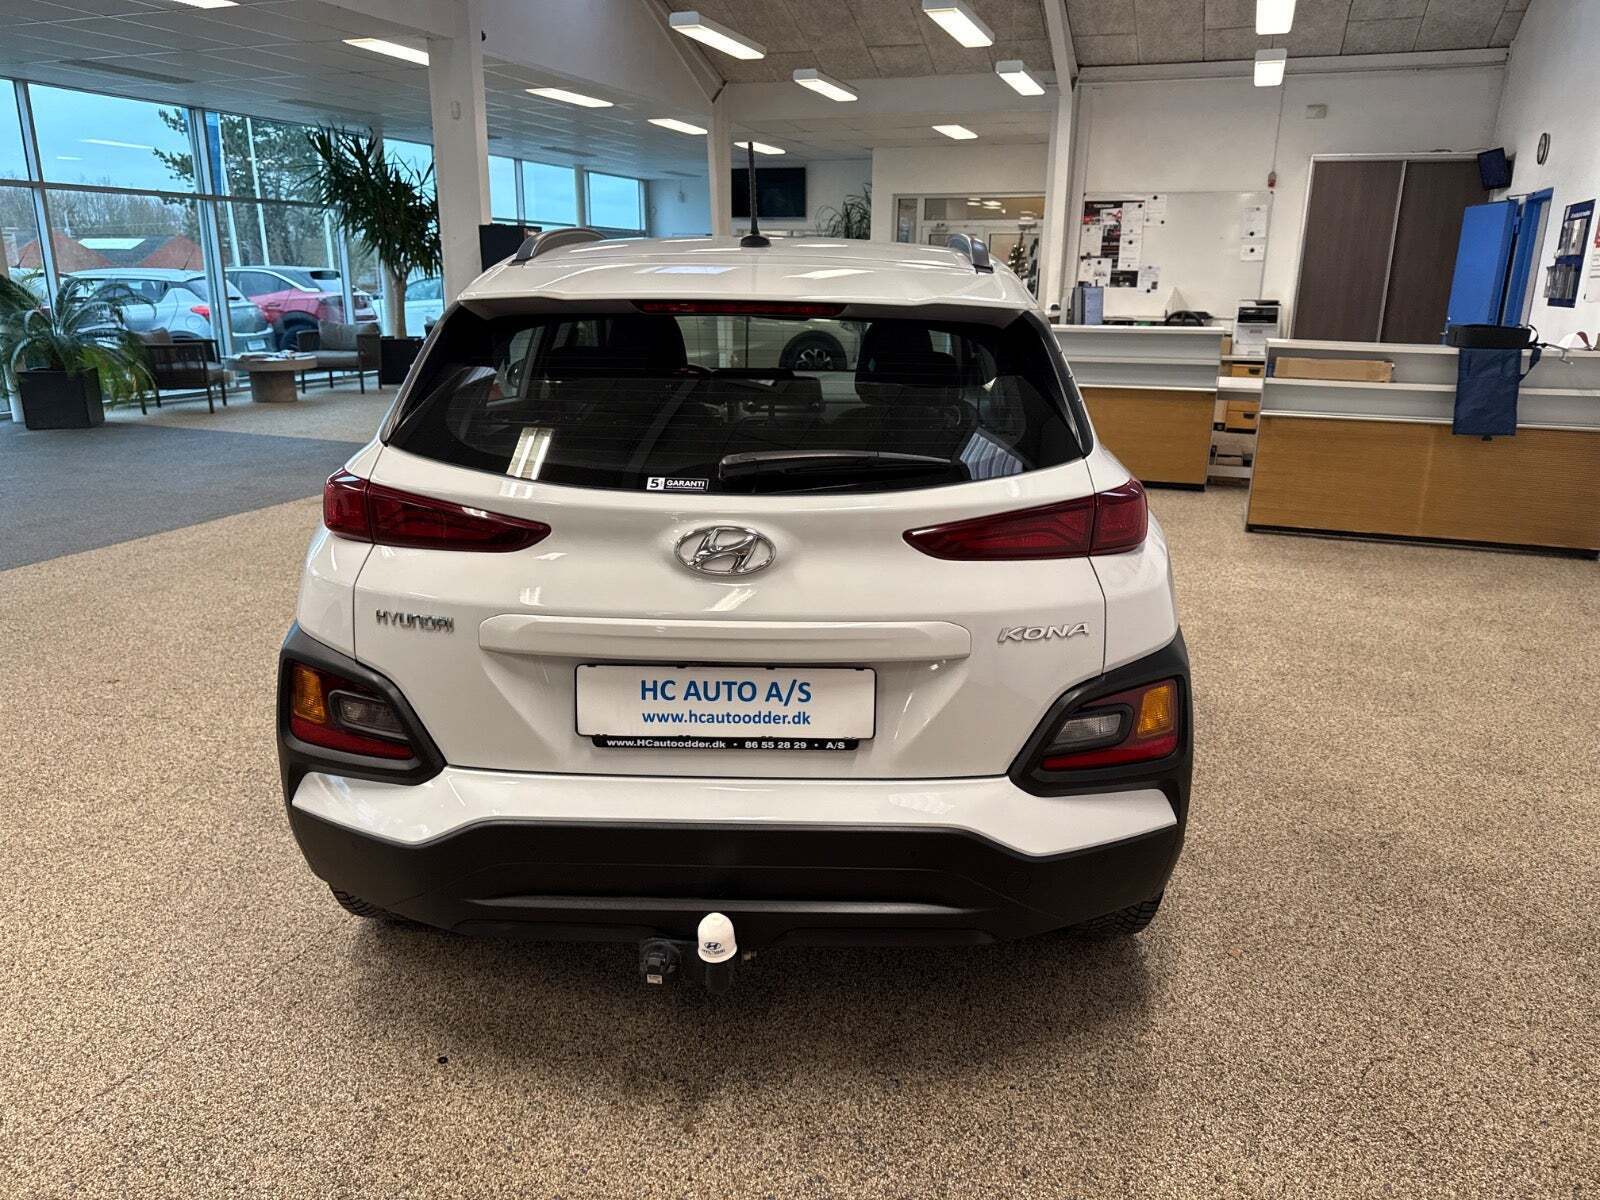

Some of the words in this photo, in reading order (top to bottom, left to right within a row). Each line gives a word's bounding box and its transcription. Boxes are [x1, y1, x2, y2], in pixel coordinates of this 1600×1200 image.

[650, 478, 659, 488] 5
[666, 479, 705, 487] GARANTI
[375, 608, 455, 633] HYUNDAI
[997, 622, 1090, 644] KONA
[641, 679, 676, 701] HC
[683, 680, 757, 702] AUTO
[764, 679, 812, 706] A/S
[642, 709, 811, 725] www.hcautoodder.dk
[606, 738, 726, 749] www.HCautoodder.dk
[744, 740, 759, 749] 86
[760, 740, 775, 749] 55
[777, 740, 791, 749] 28
[793, 740, 807, 749] 29
[825, 740, 845, 750] A/S
